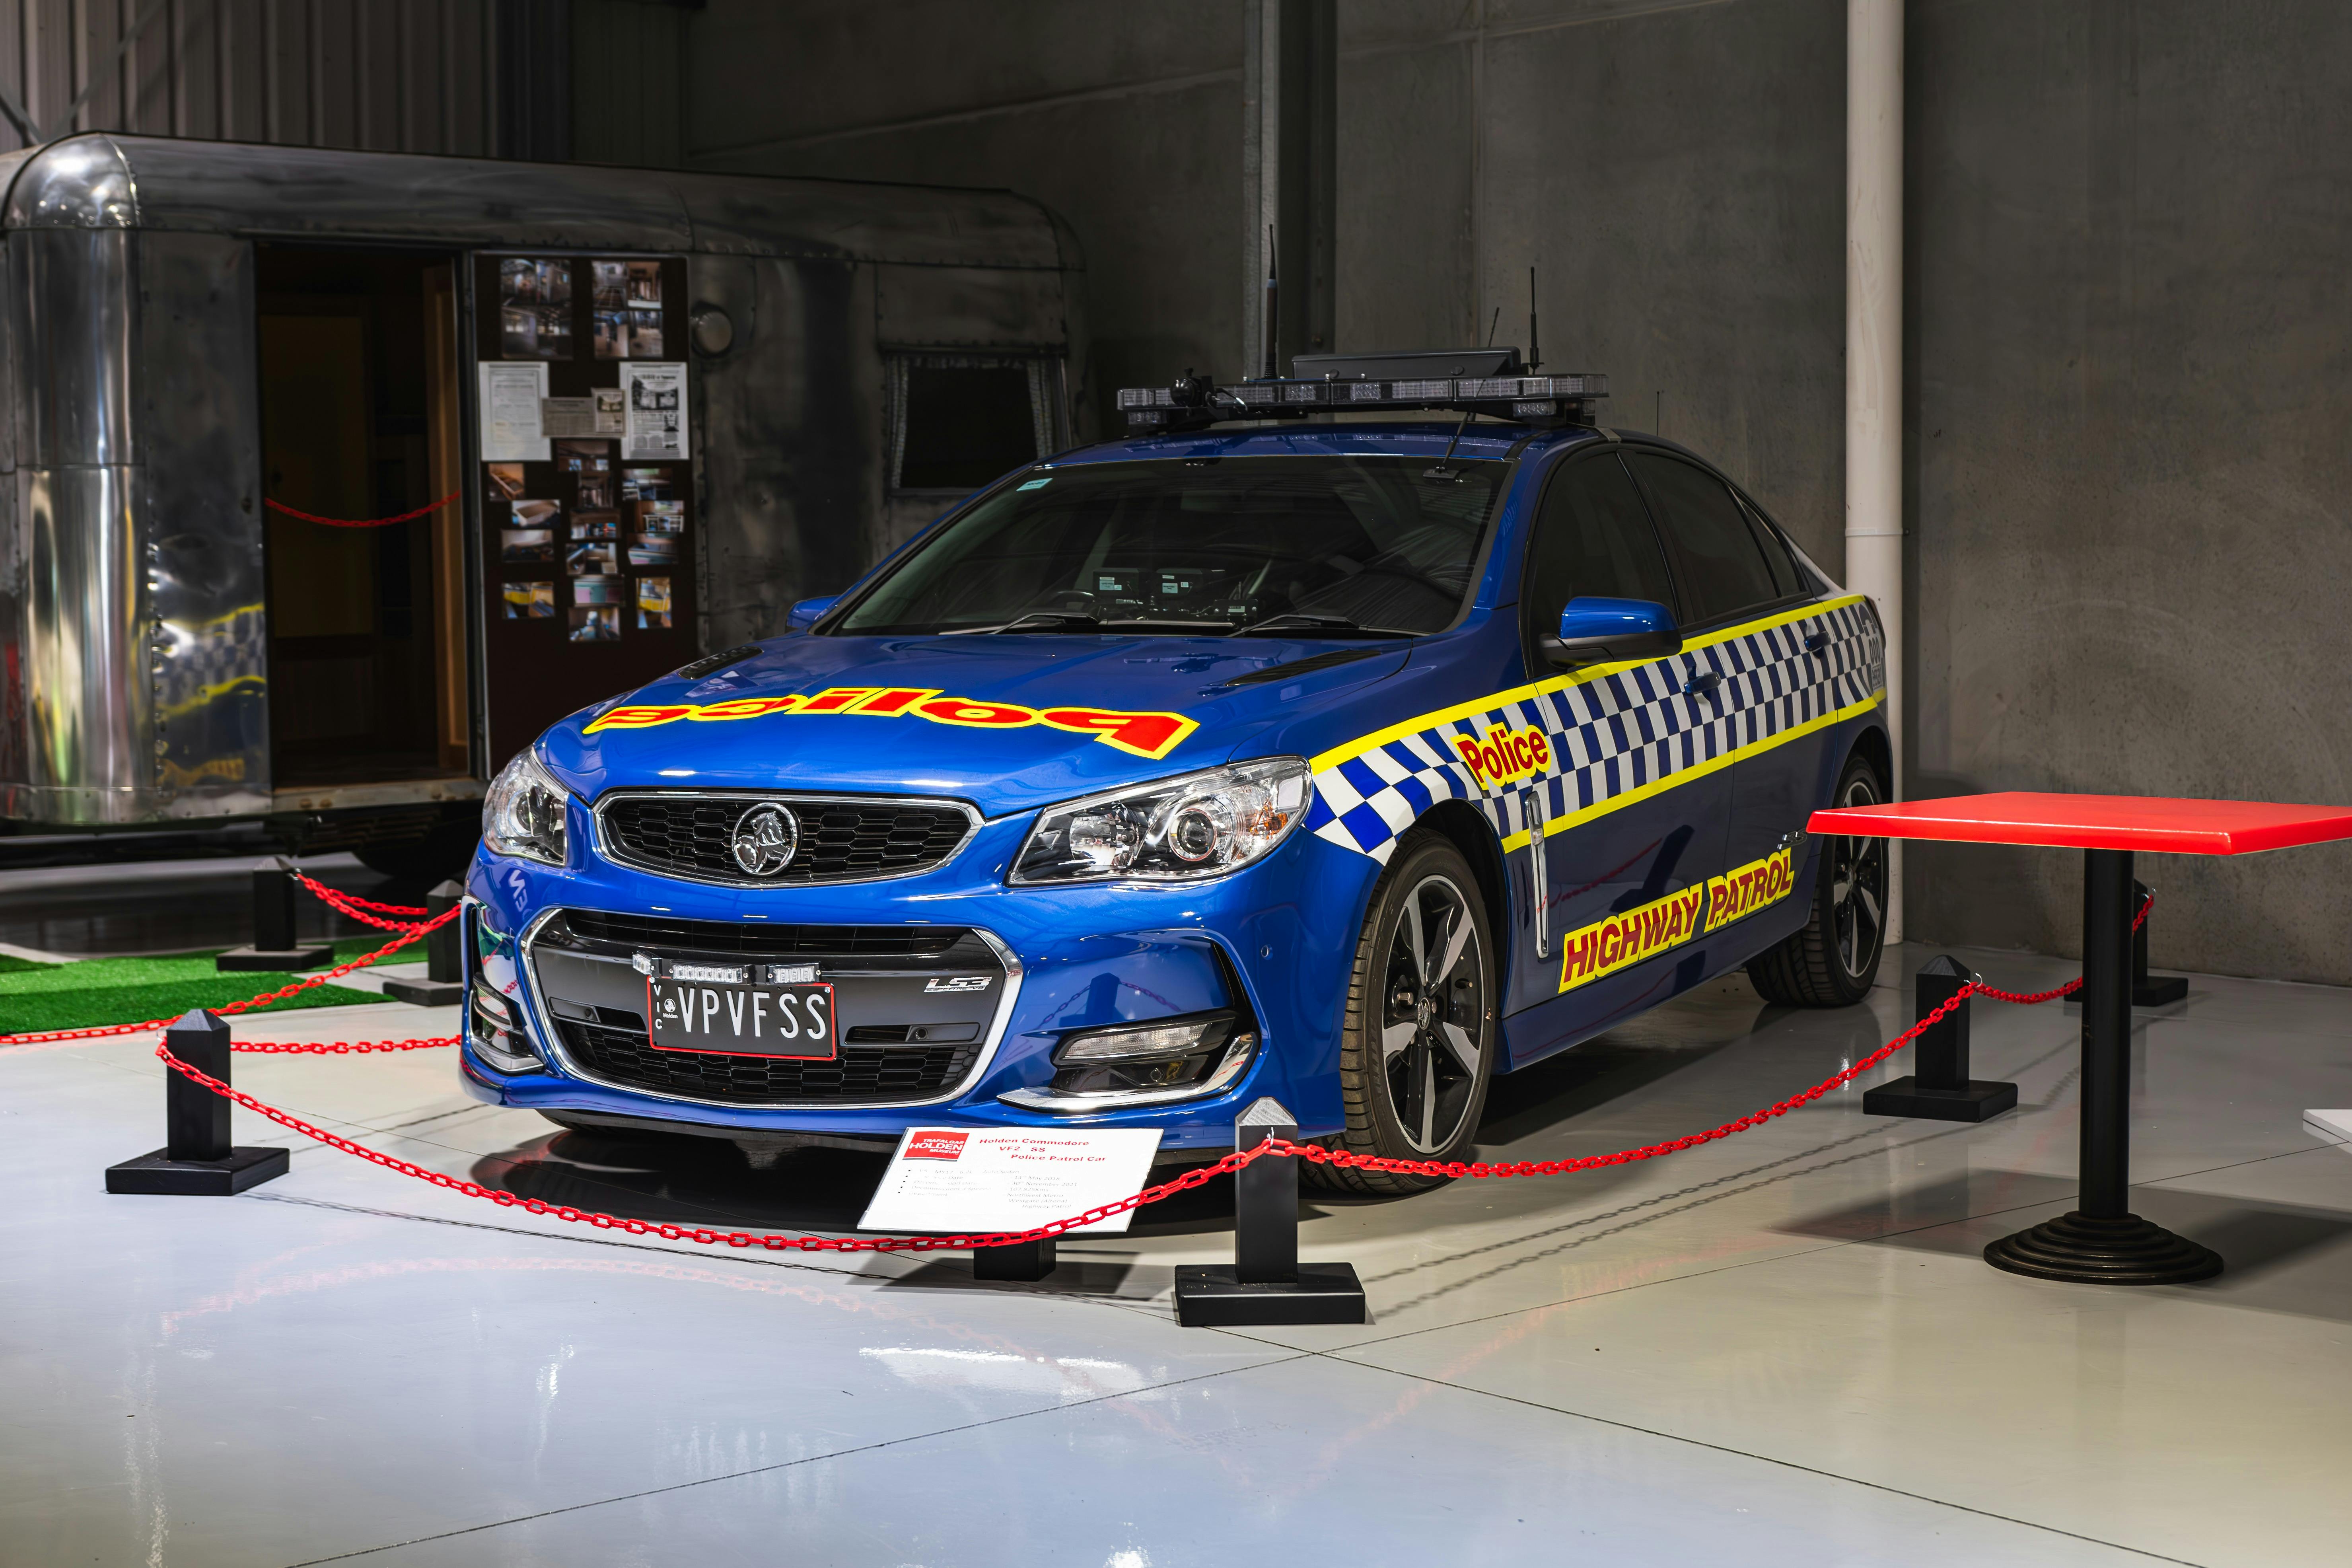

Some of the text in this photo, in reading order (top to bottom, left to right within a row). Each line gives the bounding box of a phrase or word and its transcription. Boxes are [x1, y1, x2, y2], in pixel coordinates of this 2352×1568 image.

[1455, 728, 1549, 784] Police
[1562, 855, 1793, 984] HIGHWAY PATROL
[653, 984, 663, 1029] VIC
[926, 977, 992, 988] LS3
[677, 986, 826, 1040] VPVFSS
